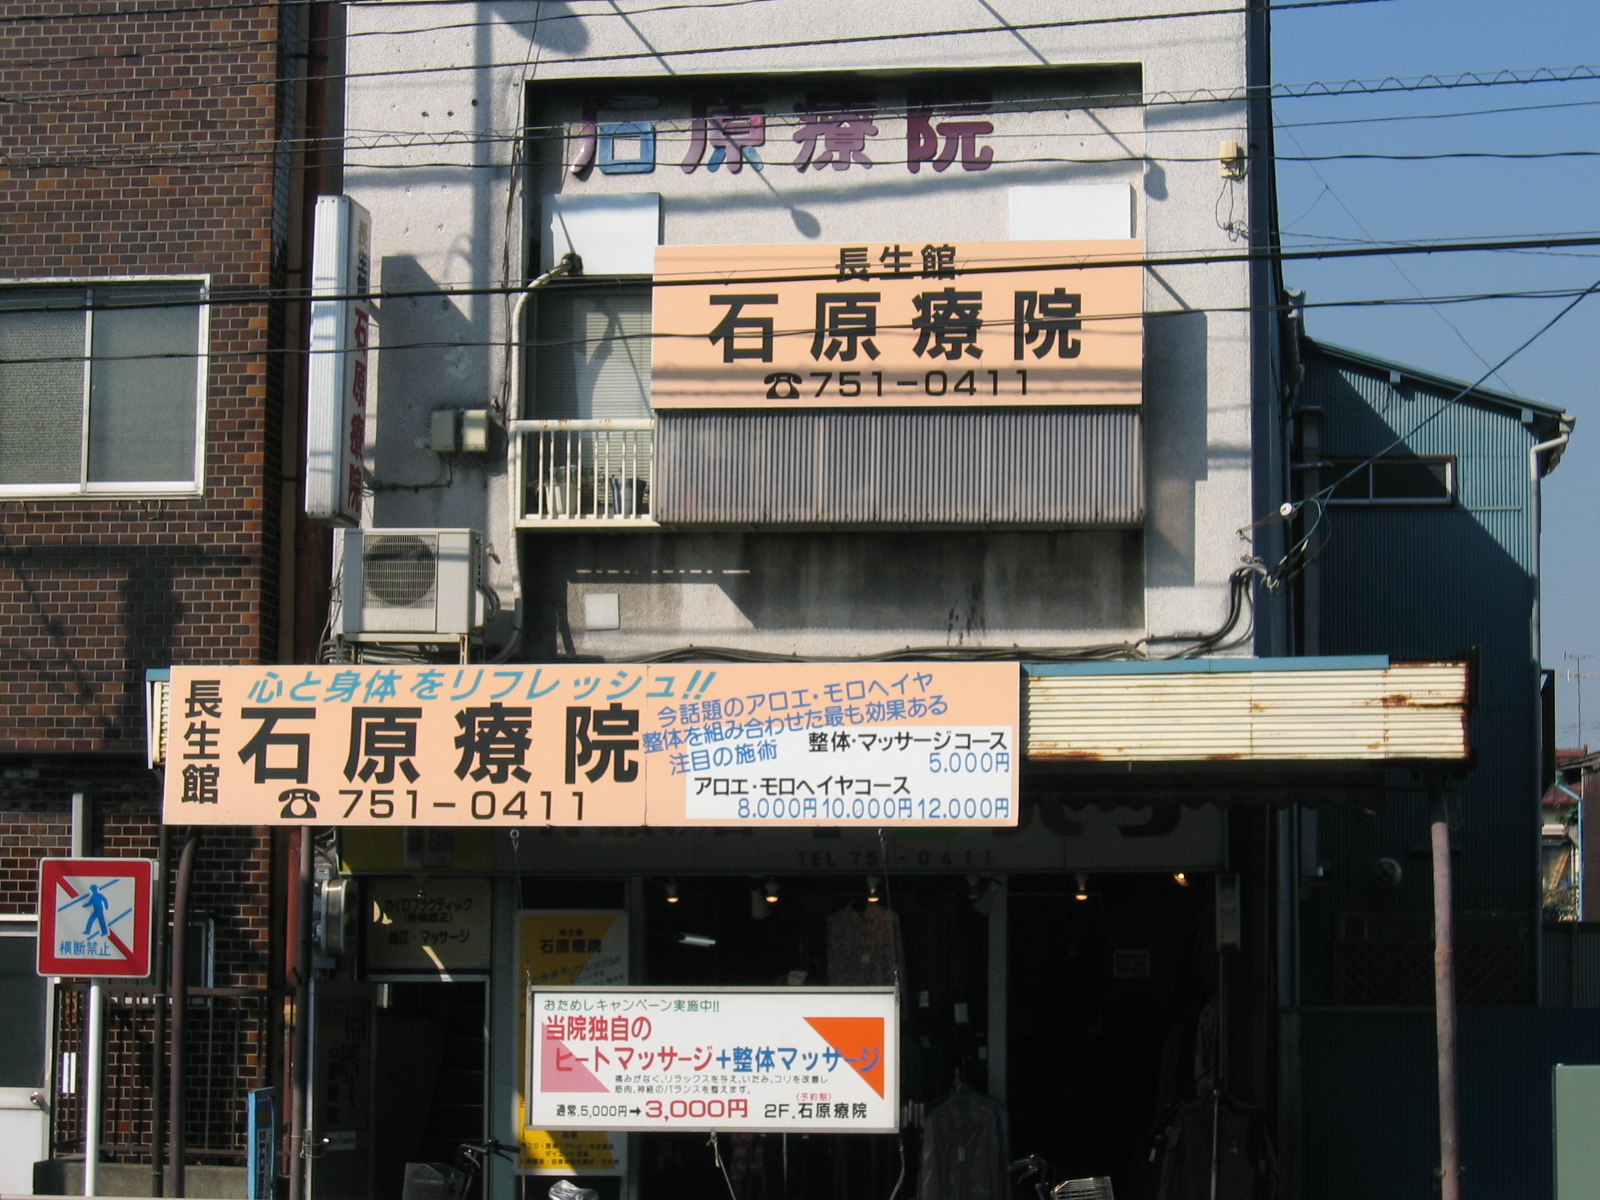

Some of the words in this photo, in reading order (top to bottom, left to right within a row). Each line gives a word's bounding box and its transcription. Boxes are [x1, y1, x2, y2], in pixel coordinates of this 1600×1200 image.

[835, 245, 957, 282] 長生館
[708, 287, 1082, 364] 石原療院
[814, 370, 1028, 398] 751-0411
[657, 672, 934, 728] 今話題のアロエ・モロヘイヤ
[641, 695, 949, 754] 整体を組み合わせた最も効果ある
[181, 680, 223, 804] 長生館
[237, 702, 639, 785] 石原療院
[808, 730, 1009, 753] 整体・マッサージコース
[669, 740, 778, 775] 注目の施術
[694, 776, 912, 797] アロエ・モロヘイヤコース
[339, 790, 584, 821] 751-0411
[798, 851, 837, 867] TEL
[60, 941, 111, 956] 横断禁止
[546, 1015, 652, 1042] 当院独自の
[645, 1098, 749, 1123] 3,000円
